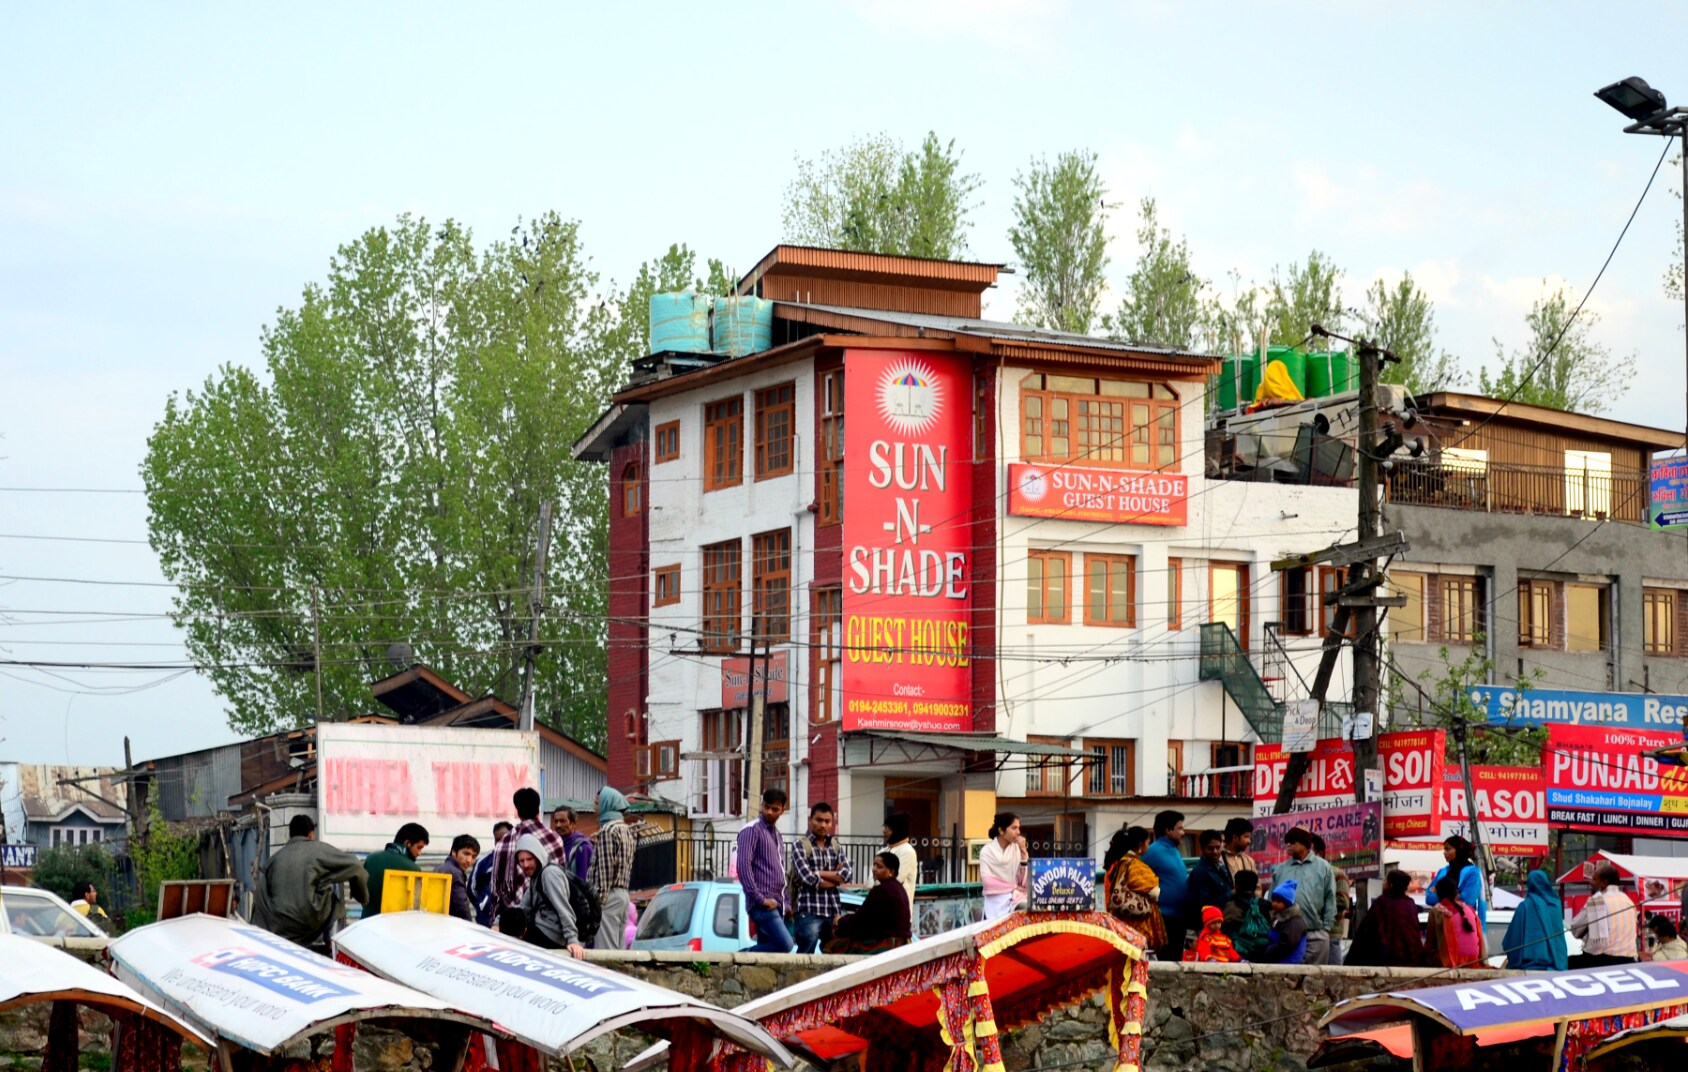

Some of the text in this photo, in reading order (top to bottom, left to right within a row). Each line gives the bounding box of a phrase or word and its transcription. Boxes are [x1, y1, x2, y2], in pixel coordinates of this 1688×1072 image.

[869, 440, 947, 492] SUN
[1053, 471, 1185, 497] SUN-N-SHADE
[1063, 492, 1170, 513] GUEST HOUSE
[849, 545, 967, 600] SHADE
[847, 615, 969, 667] GUEST HOUSE
[1500, 691, 1628, 725] Shamyana
[1604, 733, 1635, 745] 100%
[1638, 736, 1665, 747] Pure
[324, 757, 419, 817] HOTEL
[1256, 759, 1326, 796] DEHI
[1553, 749, 1659, 791] PUNJAB
[1450, 788, 1545, 819] RASOI
[1551, 810, 1575, 821] BREAK
[1577, 812, 1595, 823] FAST
[1603, 814, 1628, 825] LUNCH
[1636, 816, 1663, 827] DINNER
[1552, 792, 1653, 811] Shud Shakahari Bojnalay
[1327, 811, 1362, 829] CARE
[1067, 867, 1094, 896] PALACE
[160, 967, 181, 982] We
[177, 972, 236, 1001] understand
[227, 957, 342, 998] HDFC BANK
[416, 956, 573, 1016] We understand your world
[486, 949, 615, 993] HDFC BANK
[1455, 968, 1680, 1011] AIRCEL
